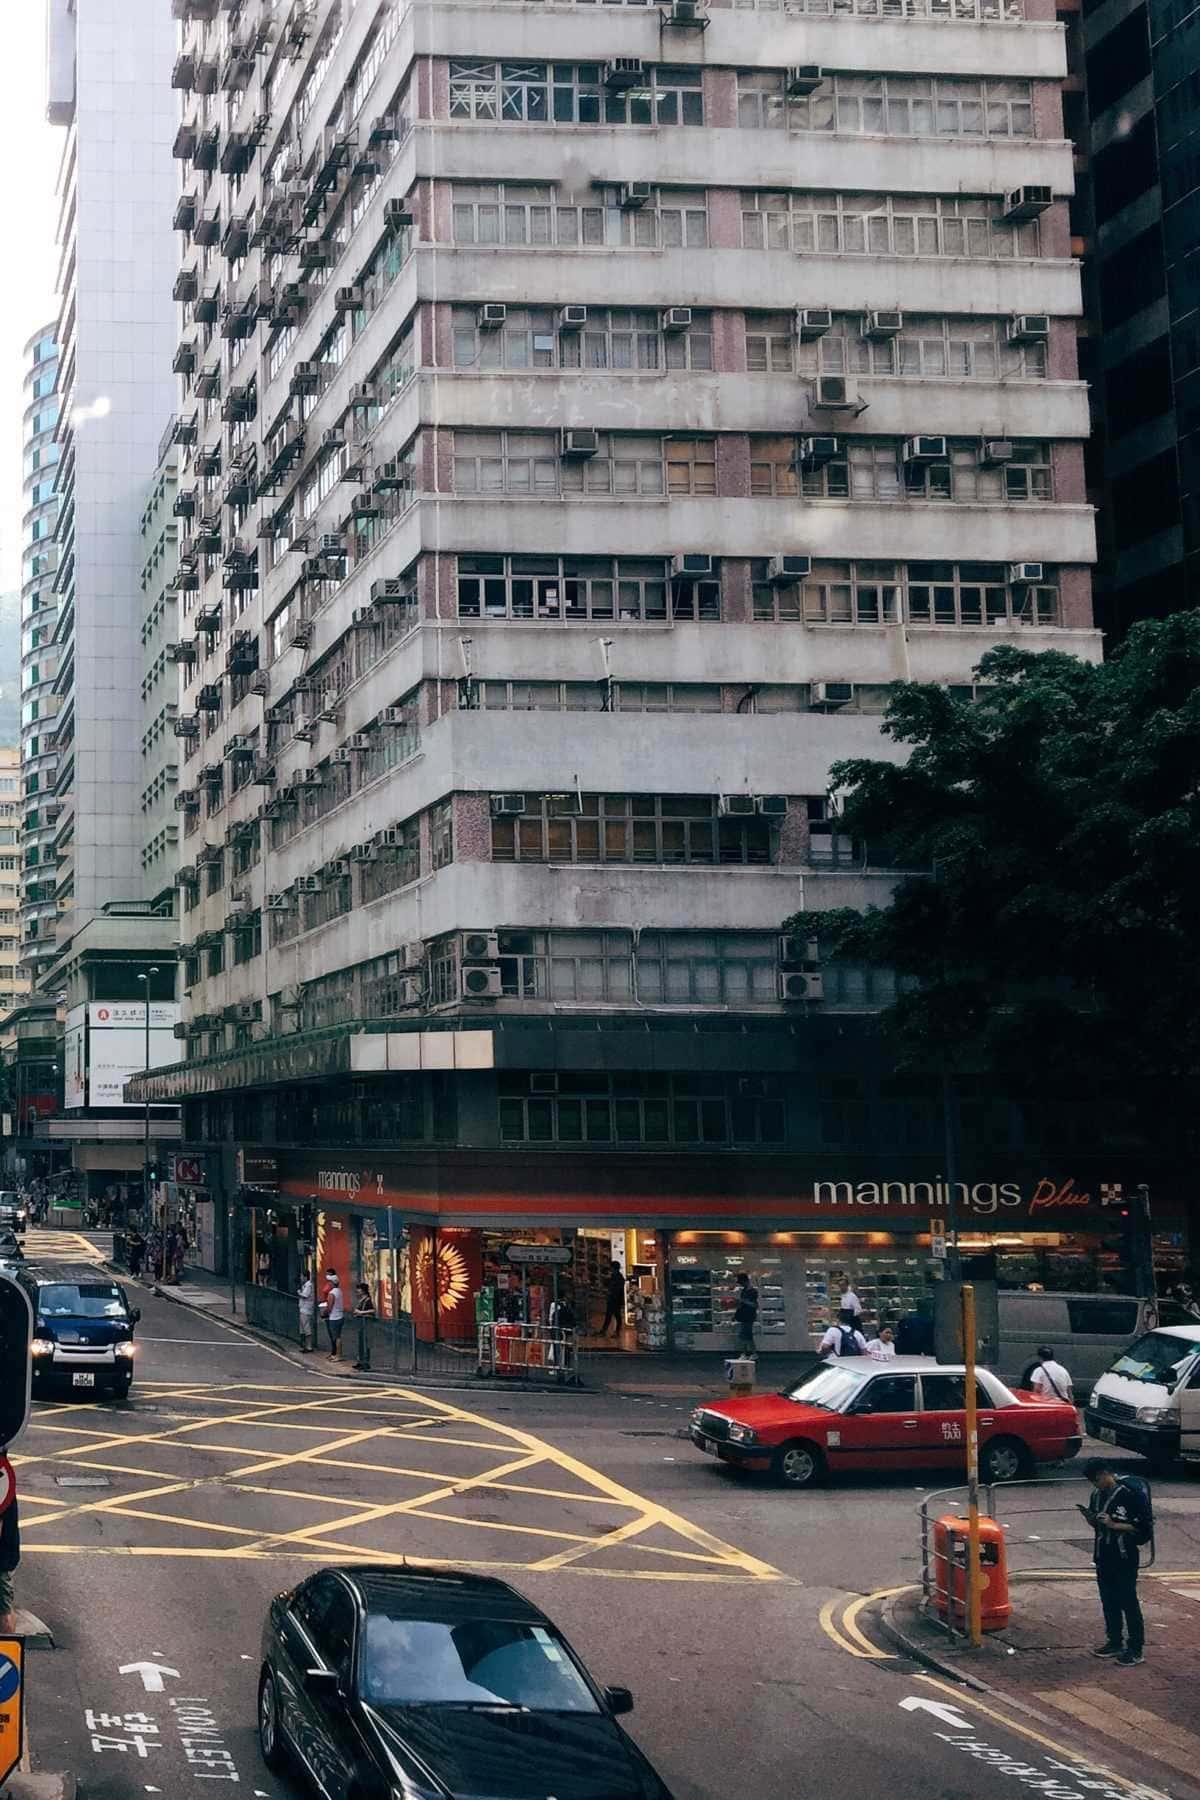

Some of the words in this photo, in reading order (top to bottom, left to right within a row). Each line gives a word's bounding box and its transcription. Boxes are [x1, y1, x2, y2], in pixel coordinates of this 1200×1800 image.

[318, 1166, 360, 1198] mannings
[814, 1174, 1021, 1214] mannings
[944, 1430, 961, 1440] TAXI
